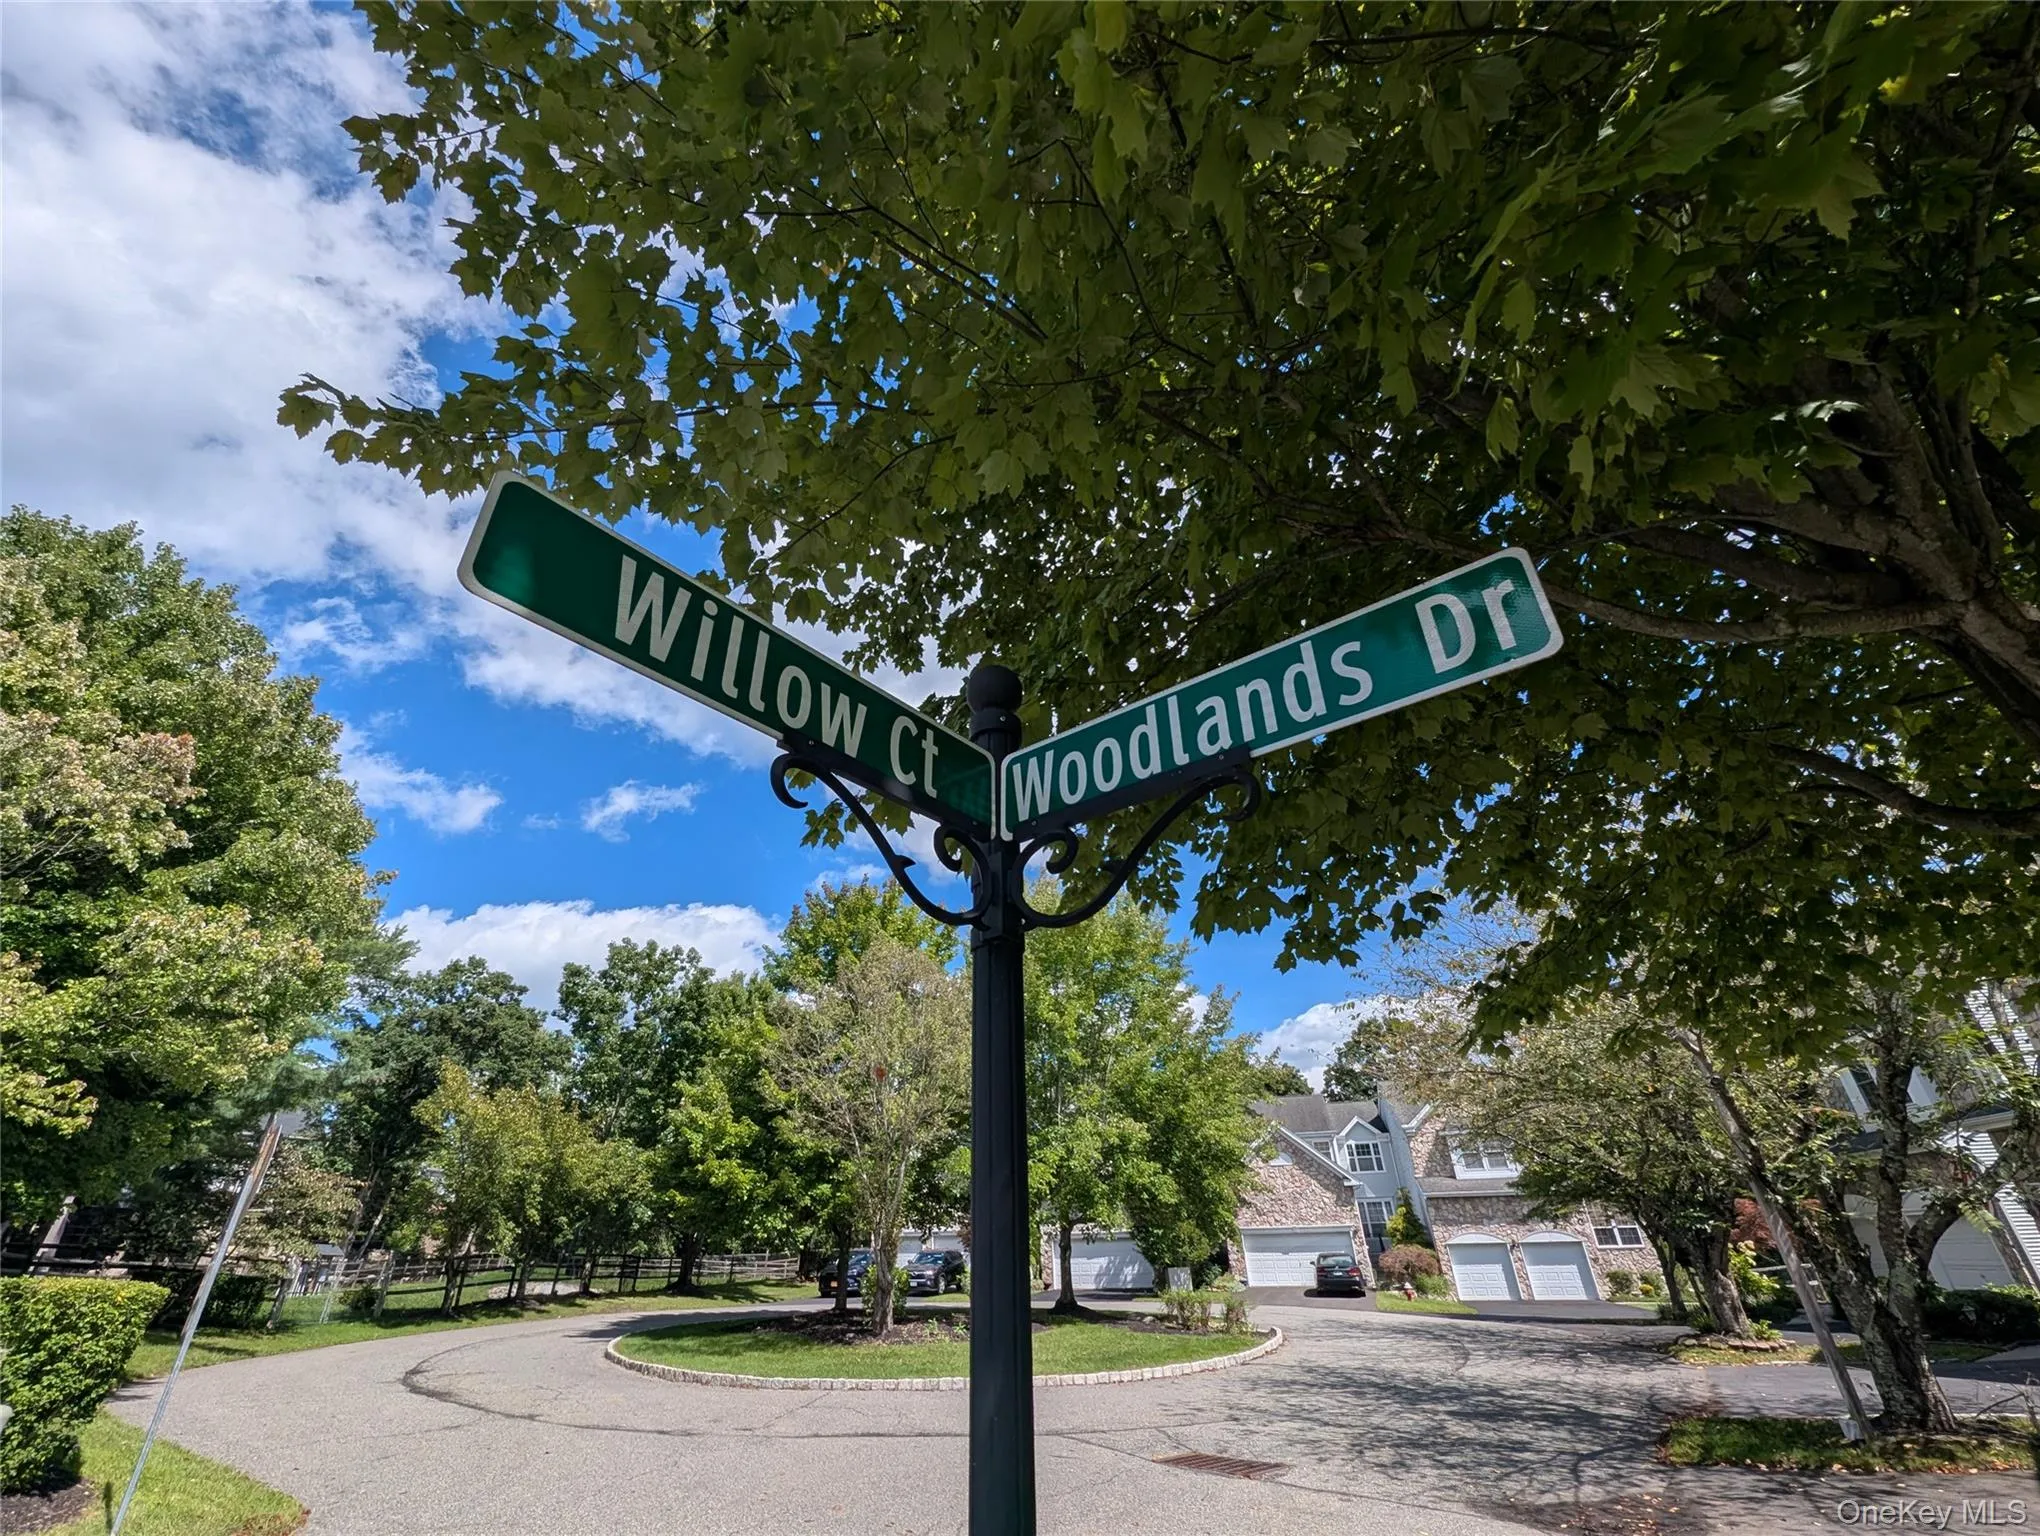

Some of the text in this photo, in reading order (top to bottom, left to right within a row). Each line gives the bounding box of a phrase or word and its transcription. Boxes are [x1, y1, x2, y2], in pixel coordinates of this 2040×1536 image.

[614, 554, 939, 799] Willow Ct
[1012, 578, 1518, 822] Woodlands Dr
